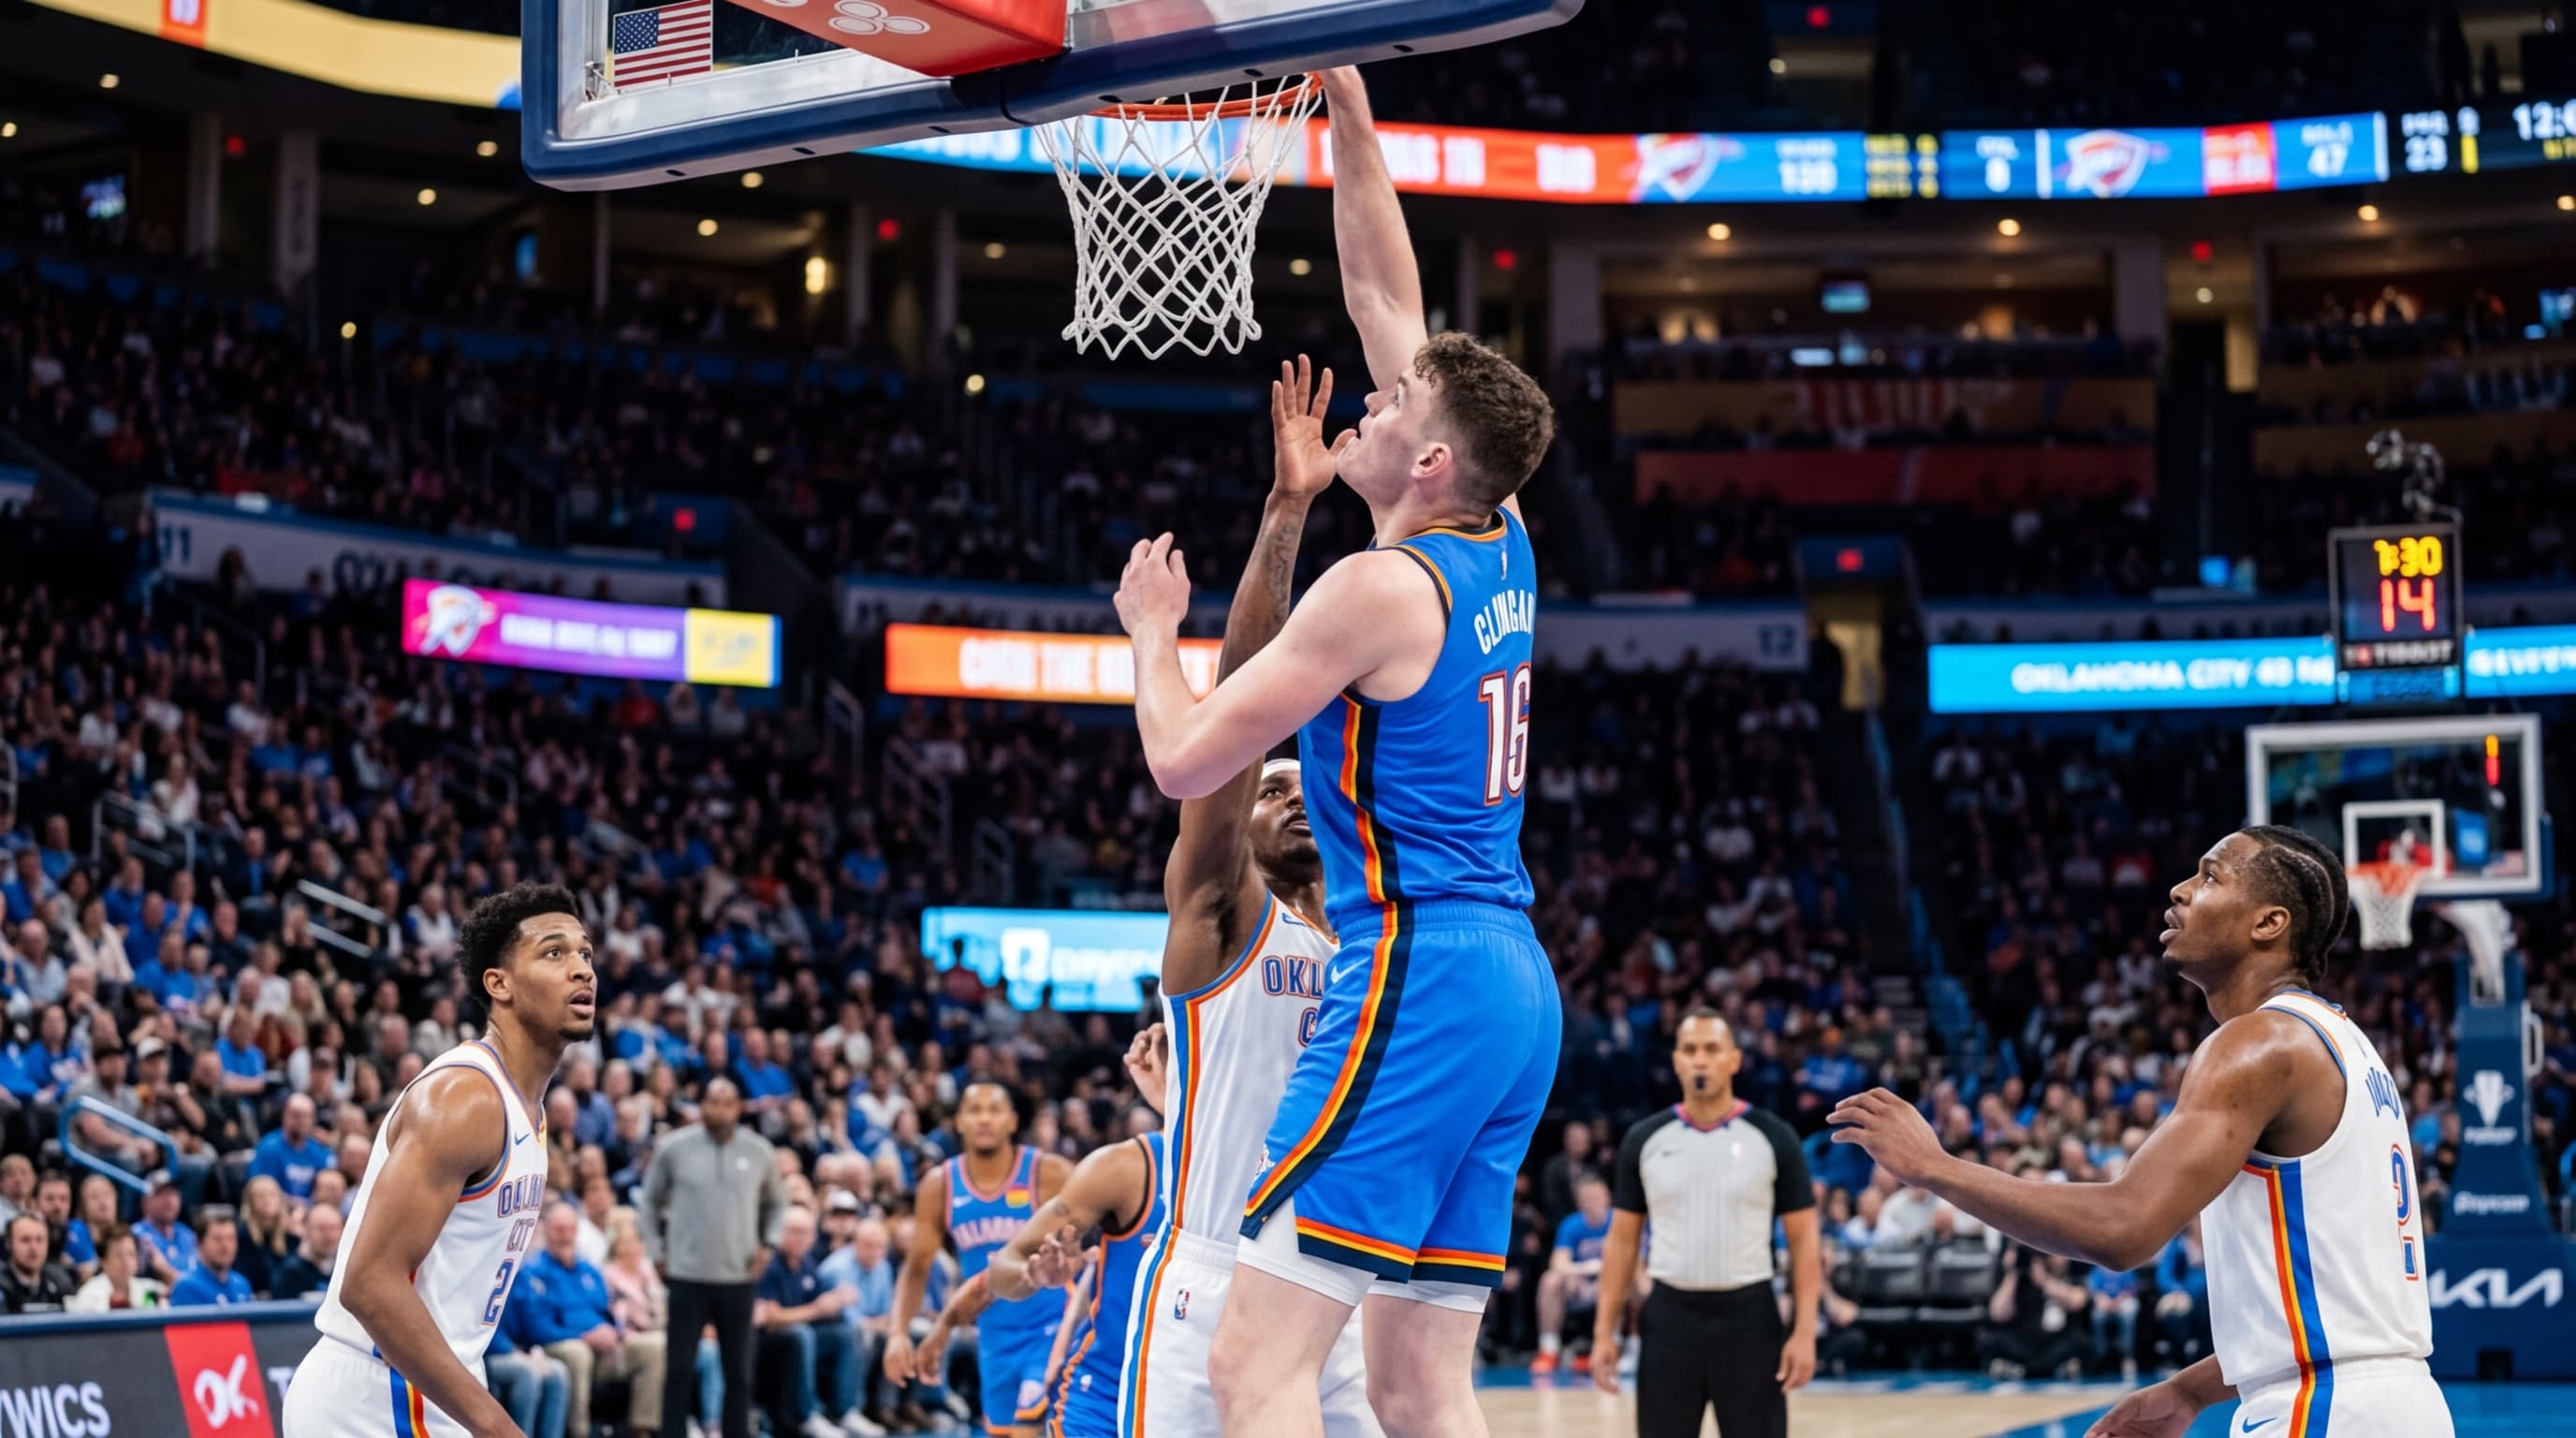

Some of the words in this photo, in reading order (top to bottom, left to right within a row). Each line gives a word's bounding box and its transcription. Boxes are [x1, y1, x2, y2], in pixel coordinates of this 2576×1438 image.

[2307, 143, 2349, 178] 47
[2373, 536, 2442, 577] 1:30
[2380, 578, 2436, 632] 14
[2011, 660, 2187, 694] OKLAHOMA
[1477, 661, 1531, 807] 16
[480, 1258, 515, 1328] 2
